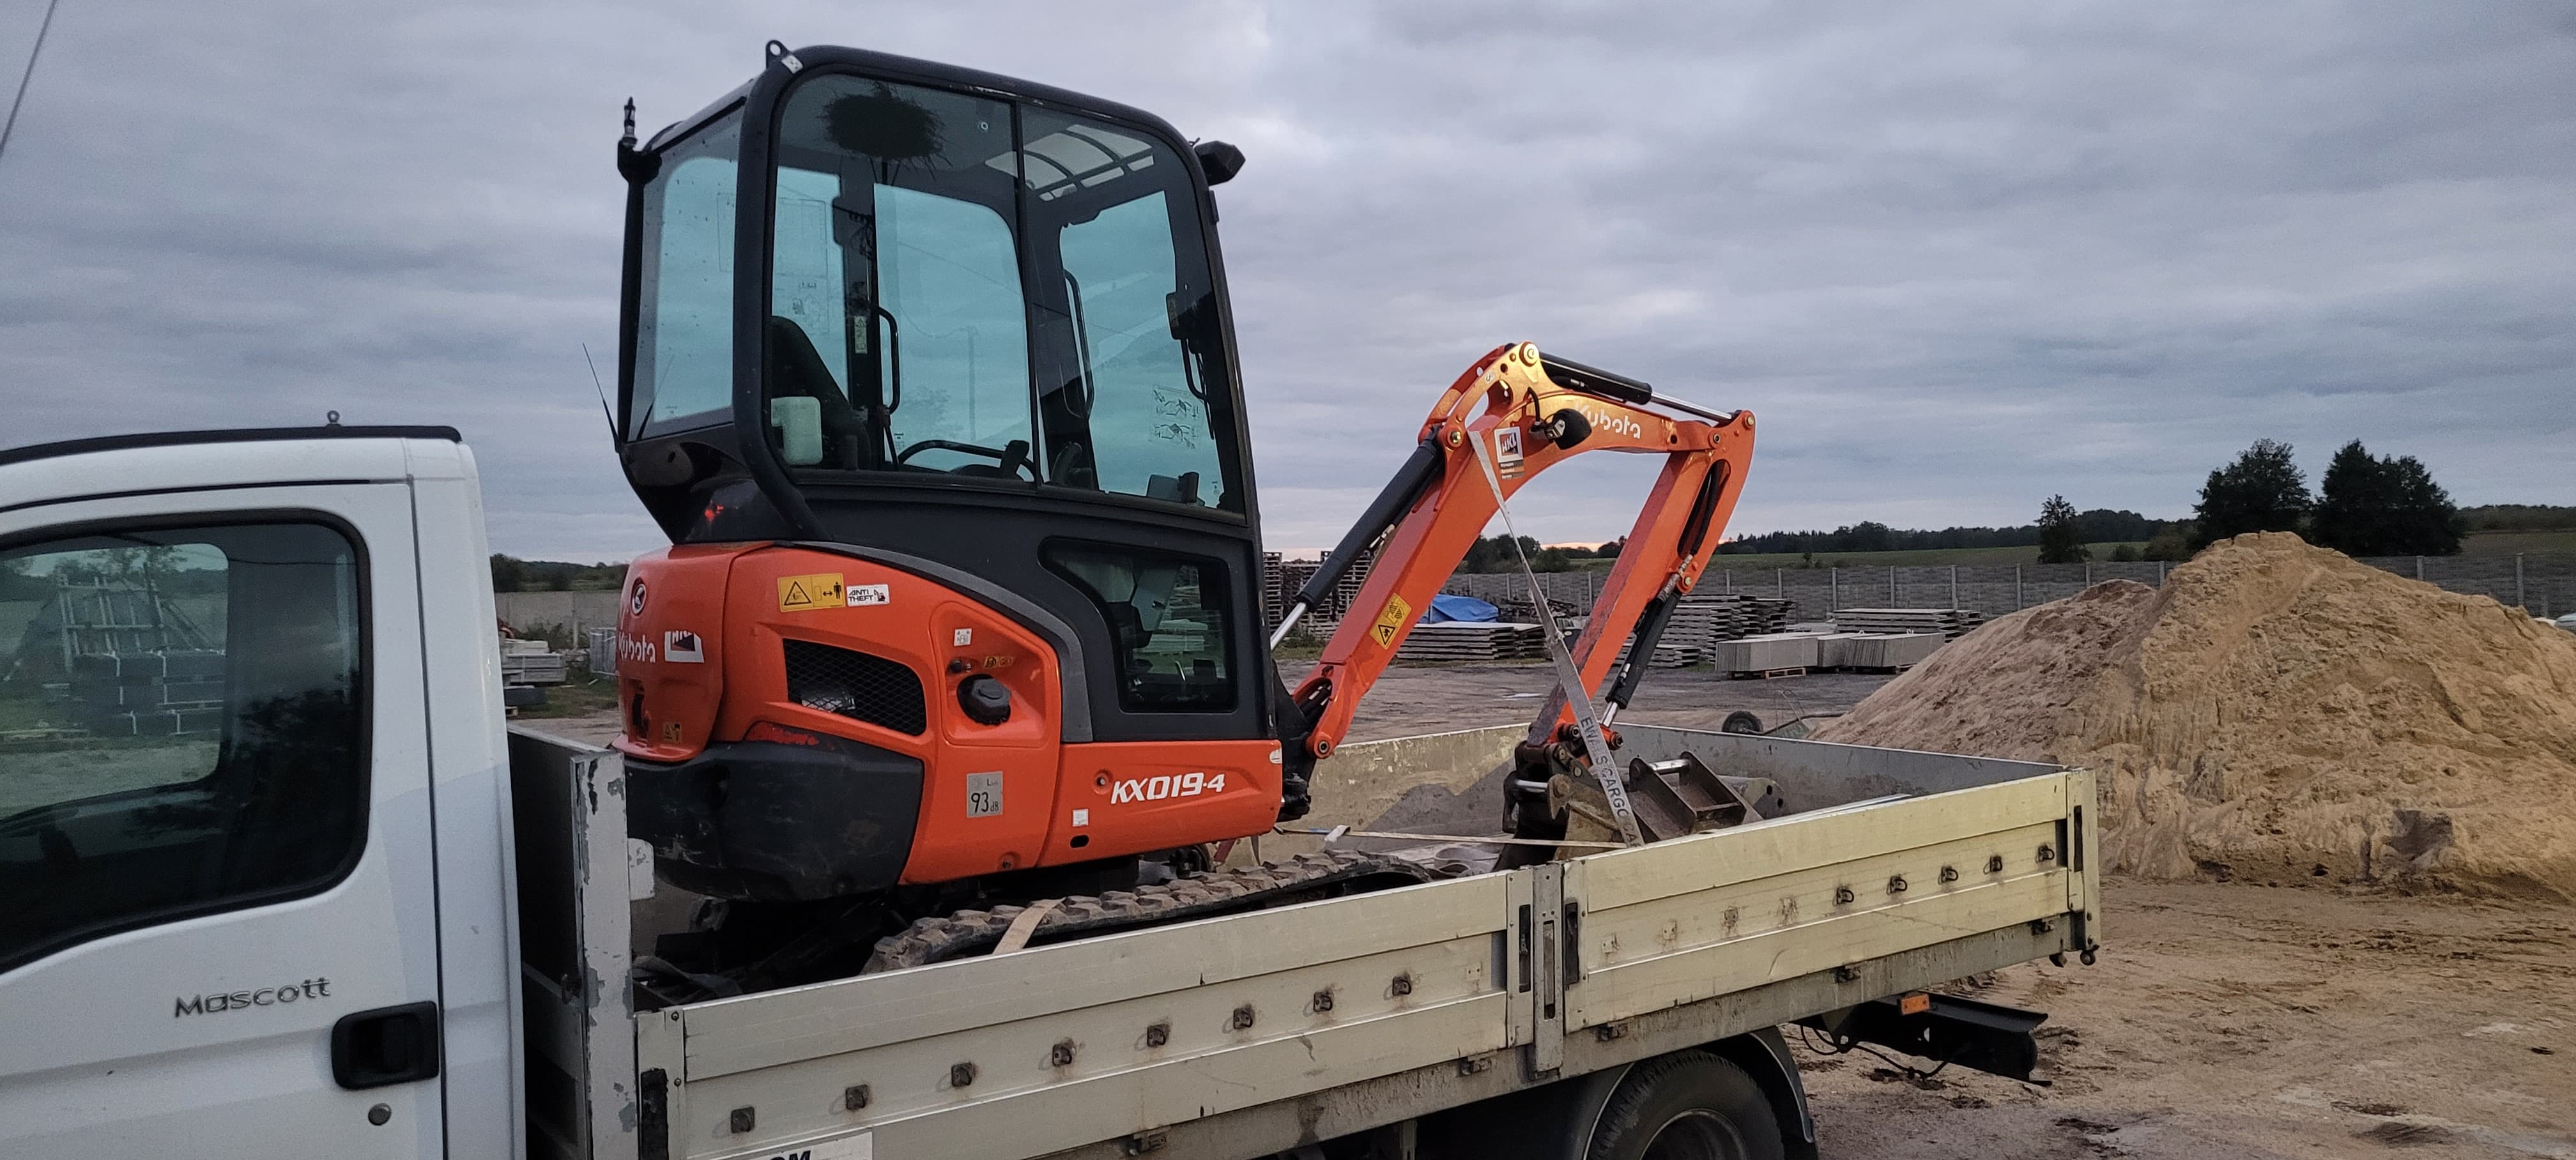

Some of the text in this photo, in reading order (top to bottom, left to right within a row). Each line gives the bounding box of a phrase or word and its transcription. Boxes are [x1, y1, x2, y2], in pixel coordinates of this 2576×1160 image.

[1501, 432, 1517, 454] HKL
[618, 631, 656, 663] Kubota
[971, 791, 999, 813] 93 dB
[174, 977, 330, 1018] Mascott
